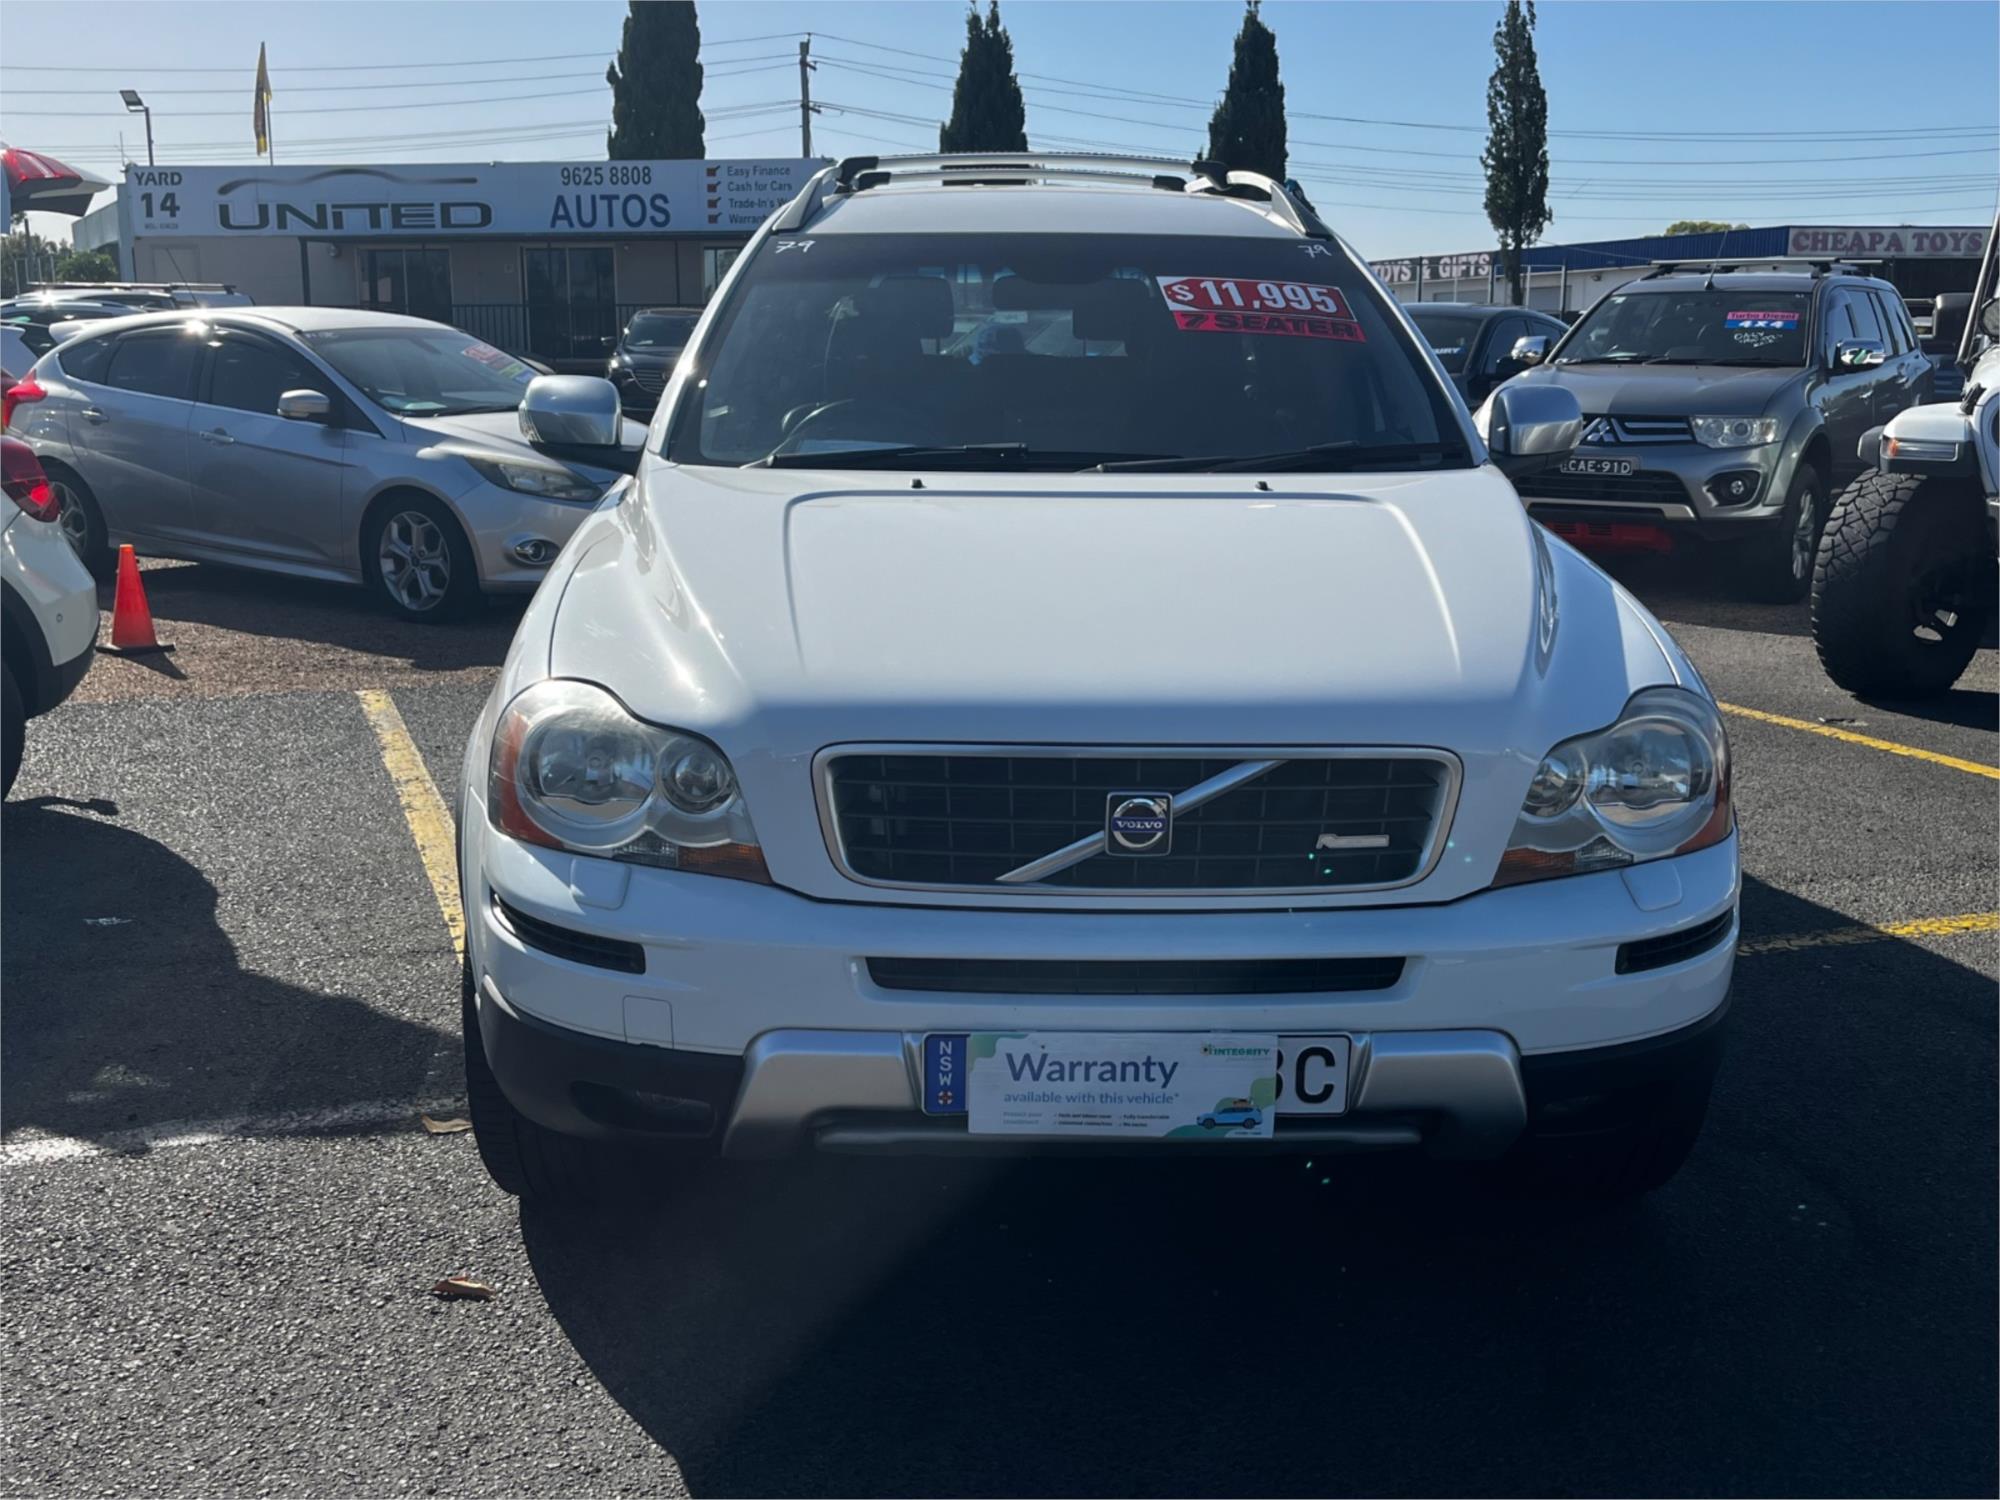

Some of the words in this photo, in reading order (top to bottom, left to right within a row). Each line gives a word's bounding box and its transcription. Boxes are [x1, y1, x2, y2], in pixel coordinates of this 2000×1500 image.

[134, 172, 182, 186] YARD
[561, 166, 604, 186] 9625
[609, 166, 652, 185] 8808
[727, 166, 750, 178] Easy
[753, 165, 791, 176] Finance
[728, 182, 752, 192] Cash
[755, 182, 768, 191] for
[770, 181, 792, 191] Cars
[141, 192, 180, 218] 14
[218, 201, 492, 230] UNITED
[550, 193, 671, 229] AUTOS
[1792, 231, 1904, 253] CHEAPA
[1911, 232, 1983, 253] TOYS
[1422, 259, 1431, 279] &
[1439, 254, 1490, 278] GIFTS
[1181, 313, 1208, 329] 7
[1214, 314, 1355, 337] SEATER
[1116, 821, 1163, 829] VOLVO
[939, 1041, 952, 1086] NSW
[1005, 1053, 1179, 1088] Warranty
[1004, 1091, 1063, 1103] available
[1066, 1092, 1096, 1103] with
[1100, 1092, 1124, 1104] this
